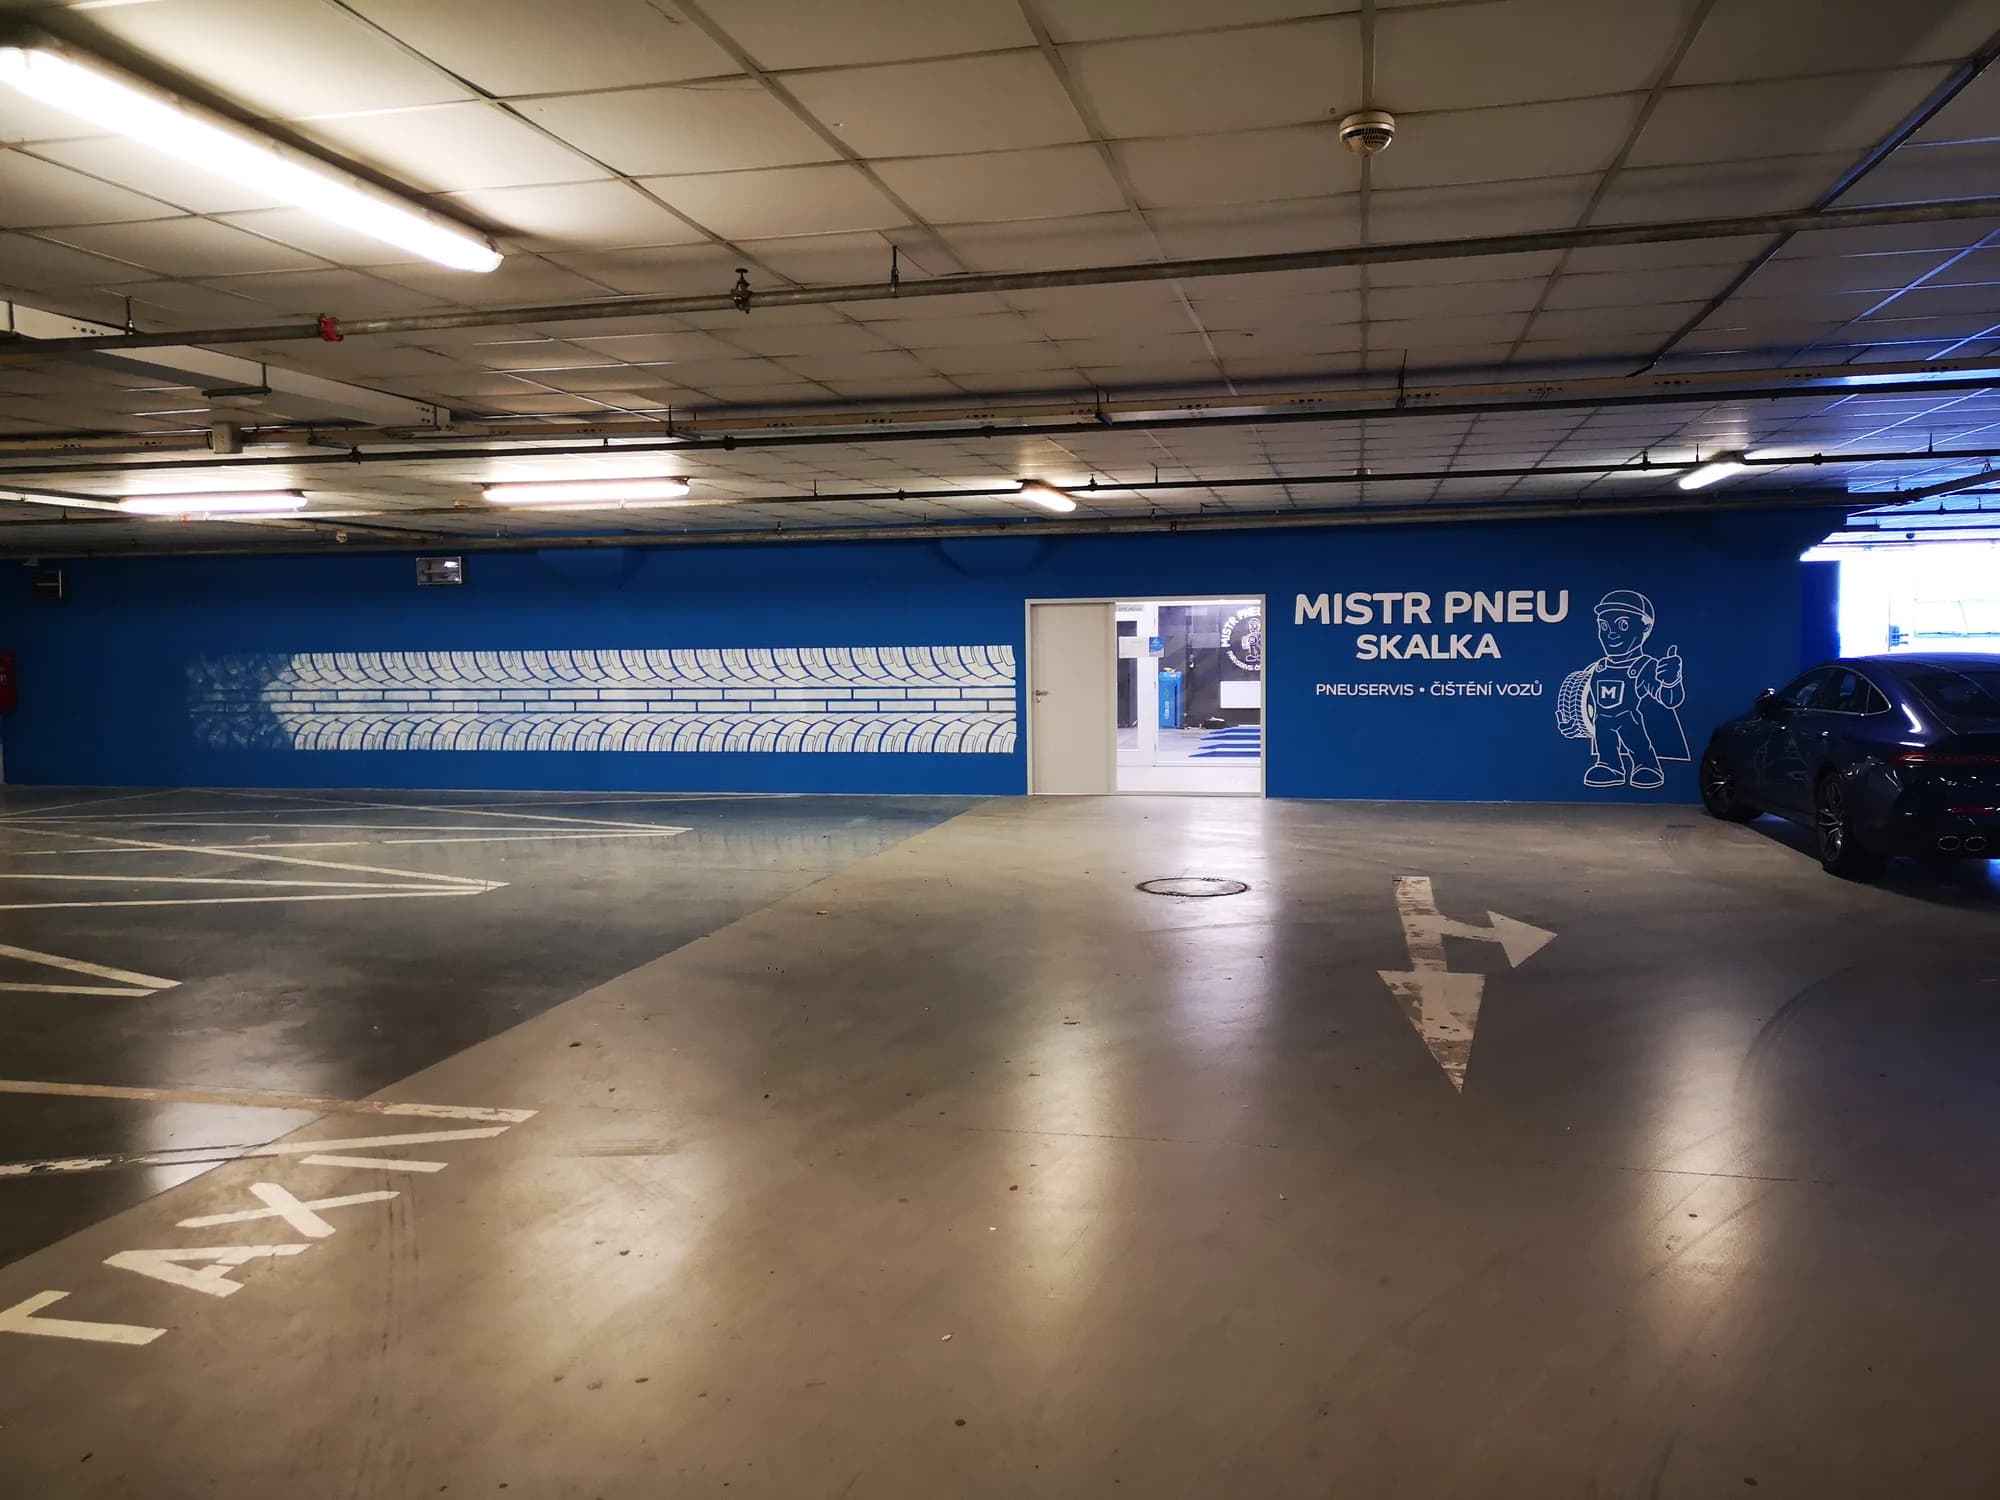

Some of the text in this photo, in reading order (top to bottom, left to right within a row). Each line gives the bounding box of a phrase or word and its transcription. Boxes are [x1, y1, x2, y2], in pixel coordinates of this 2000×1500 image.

[1294, 589, 1569, 625] MISTR PNEU
[1355, 633, 1502, 660] SKALKA
[1316, 678, 1543, 696] PNEUSERVIS ČIŠTĚNÍ VOZŮ
[1600, 686, 1616, 699] M
